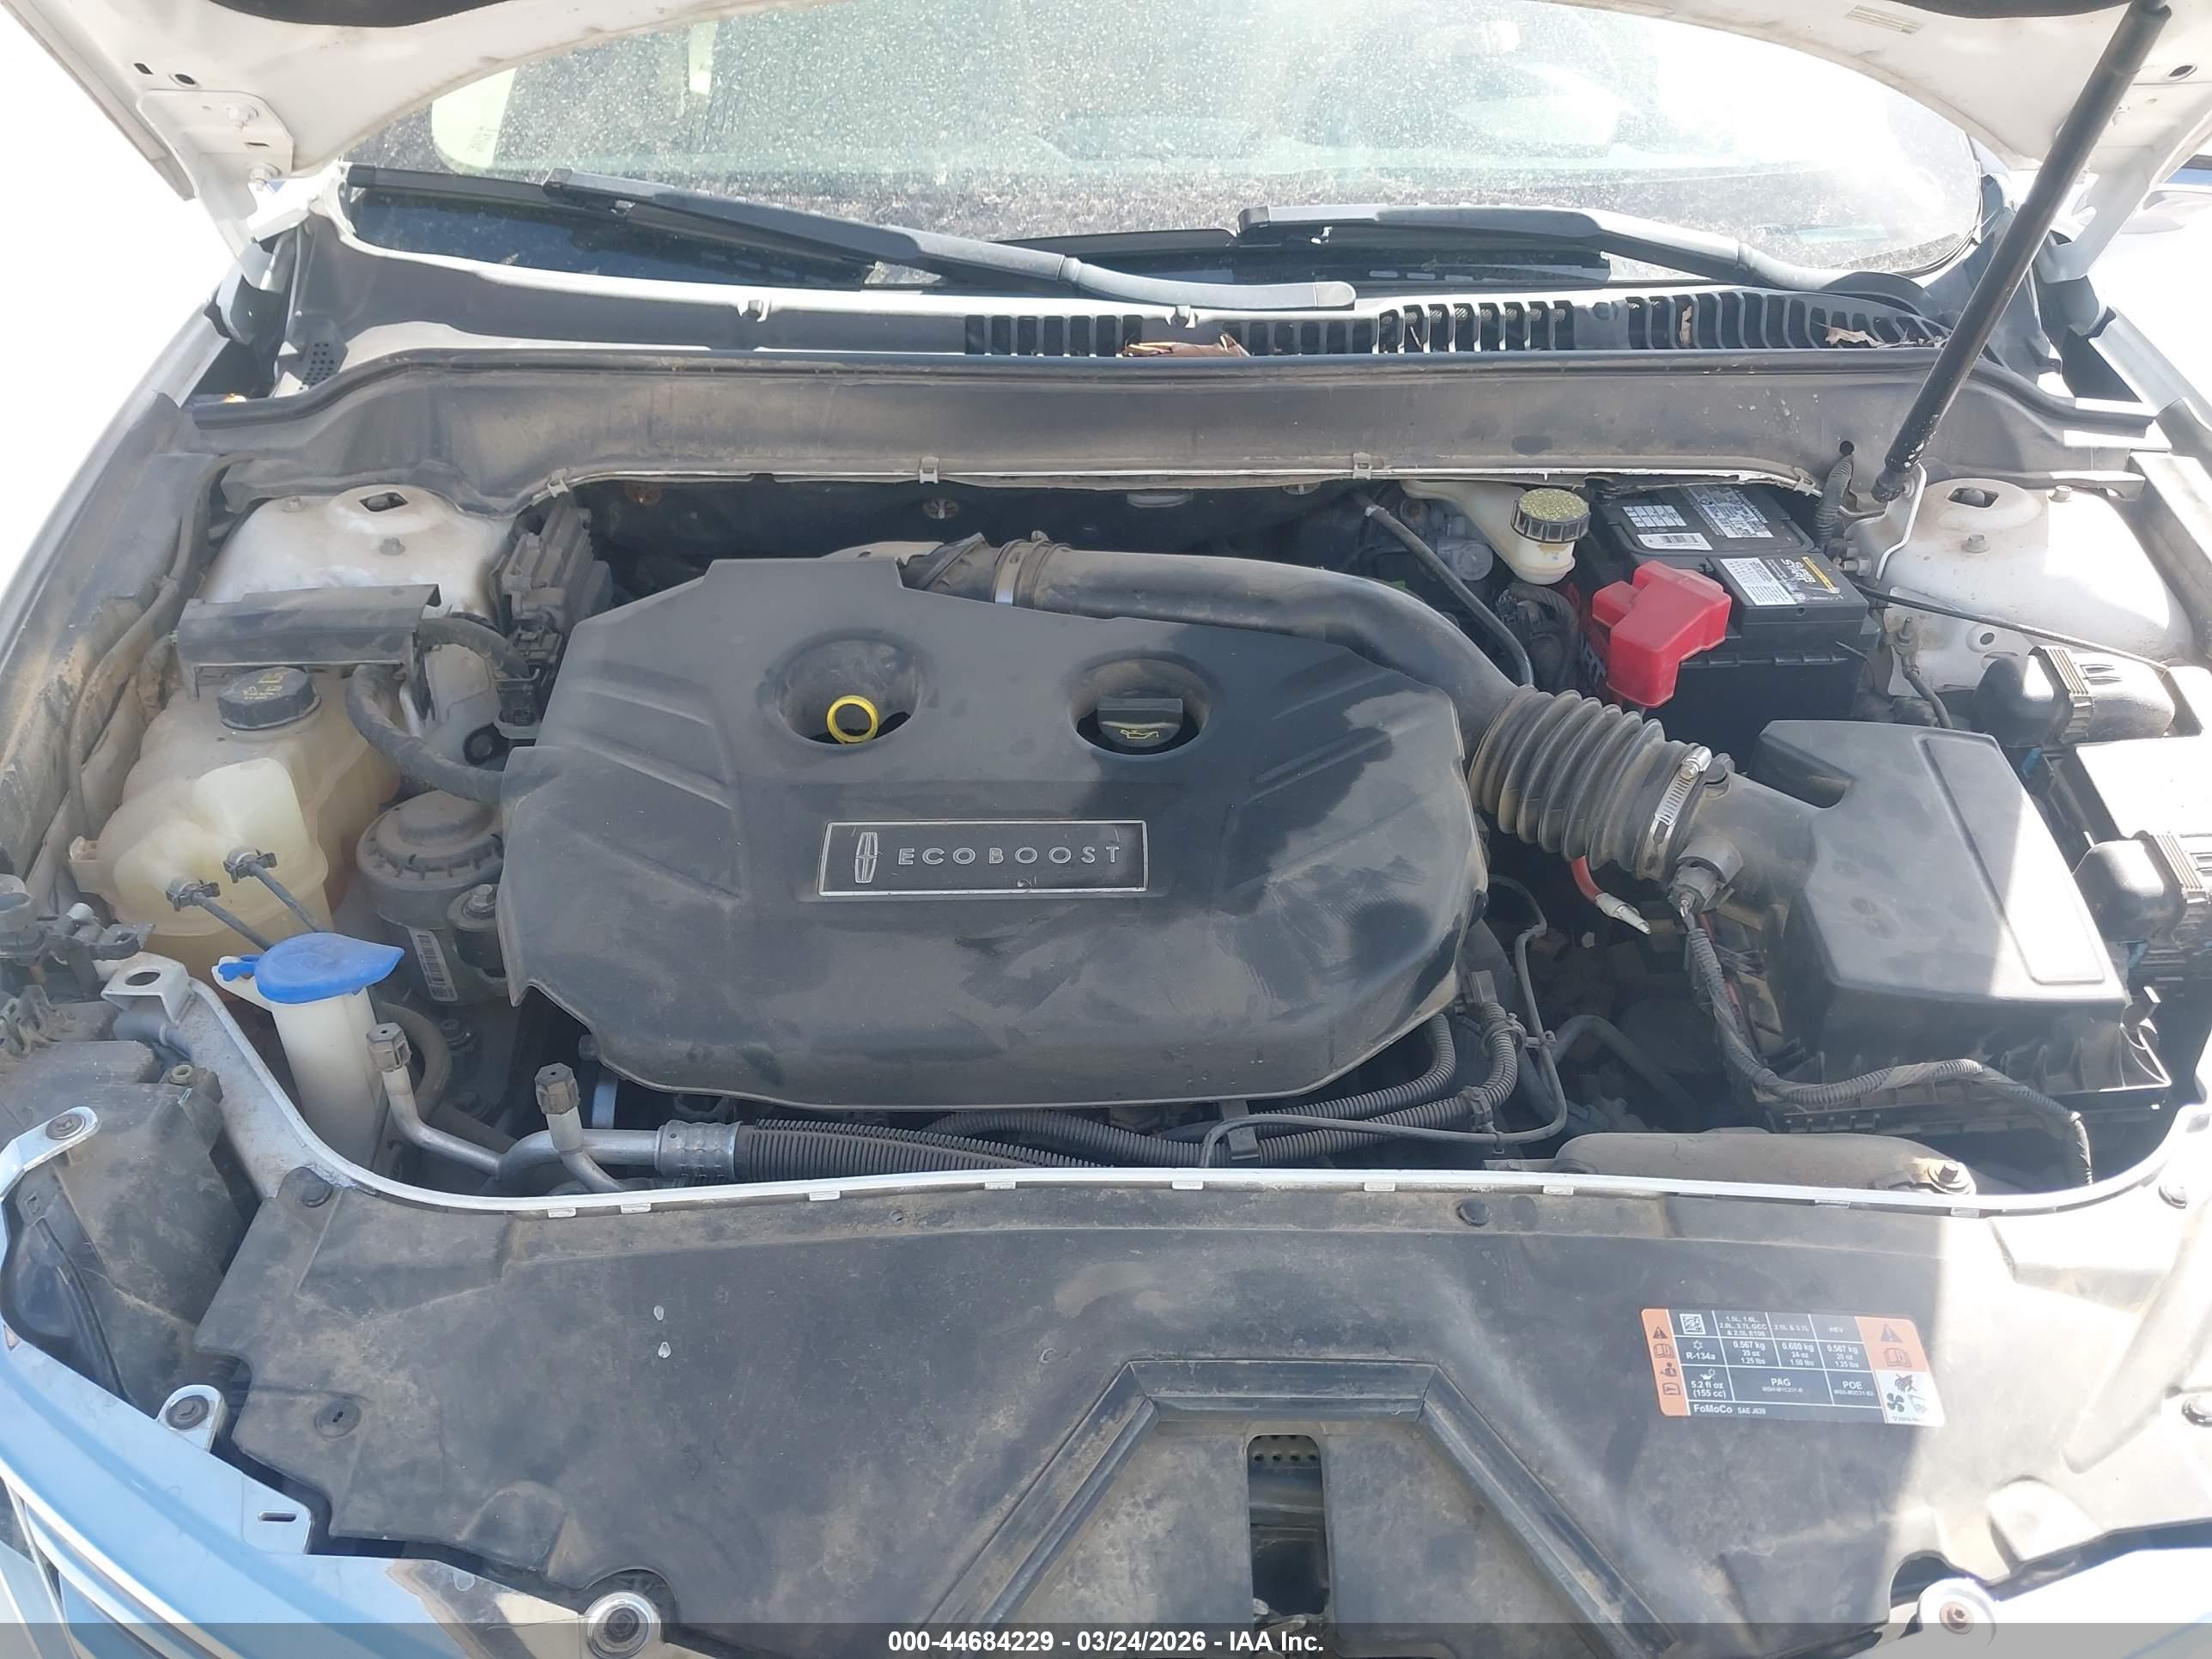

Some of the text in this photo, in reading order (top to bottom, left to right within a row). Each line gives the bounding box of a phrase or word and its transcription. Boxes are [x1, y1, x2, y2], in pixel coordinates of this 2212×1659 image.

[897, 845, 1120, 866] ECOBOOST
[1733, 1340, 1765, 1351] 0.567 kg
[1782, 1342, 1814, 1352] 0.680 kg
[1847, 1346, 1858, 1354] kg
[1686, 1352, 1716, 1360] R-134a
[1771, 1377, 1791, 1387] PAG
[1842, 1381, 1863, 1389] POE
[1692, 1389, 1726, 1399] (155 cc)
[1693, 1404, 1733, 1414] FoMoCo
